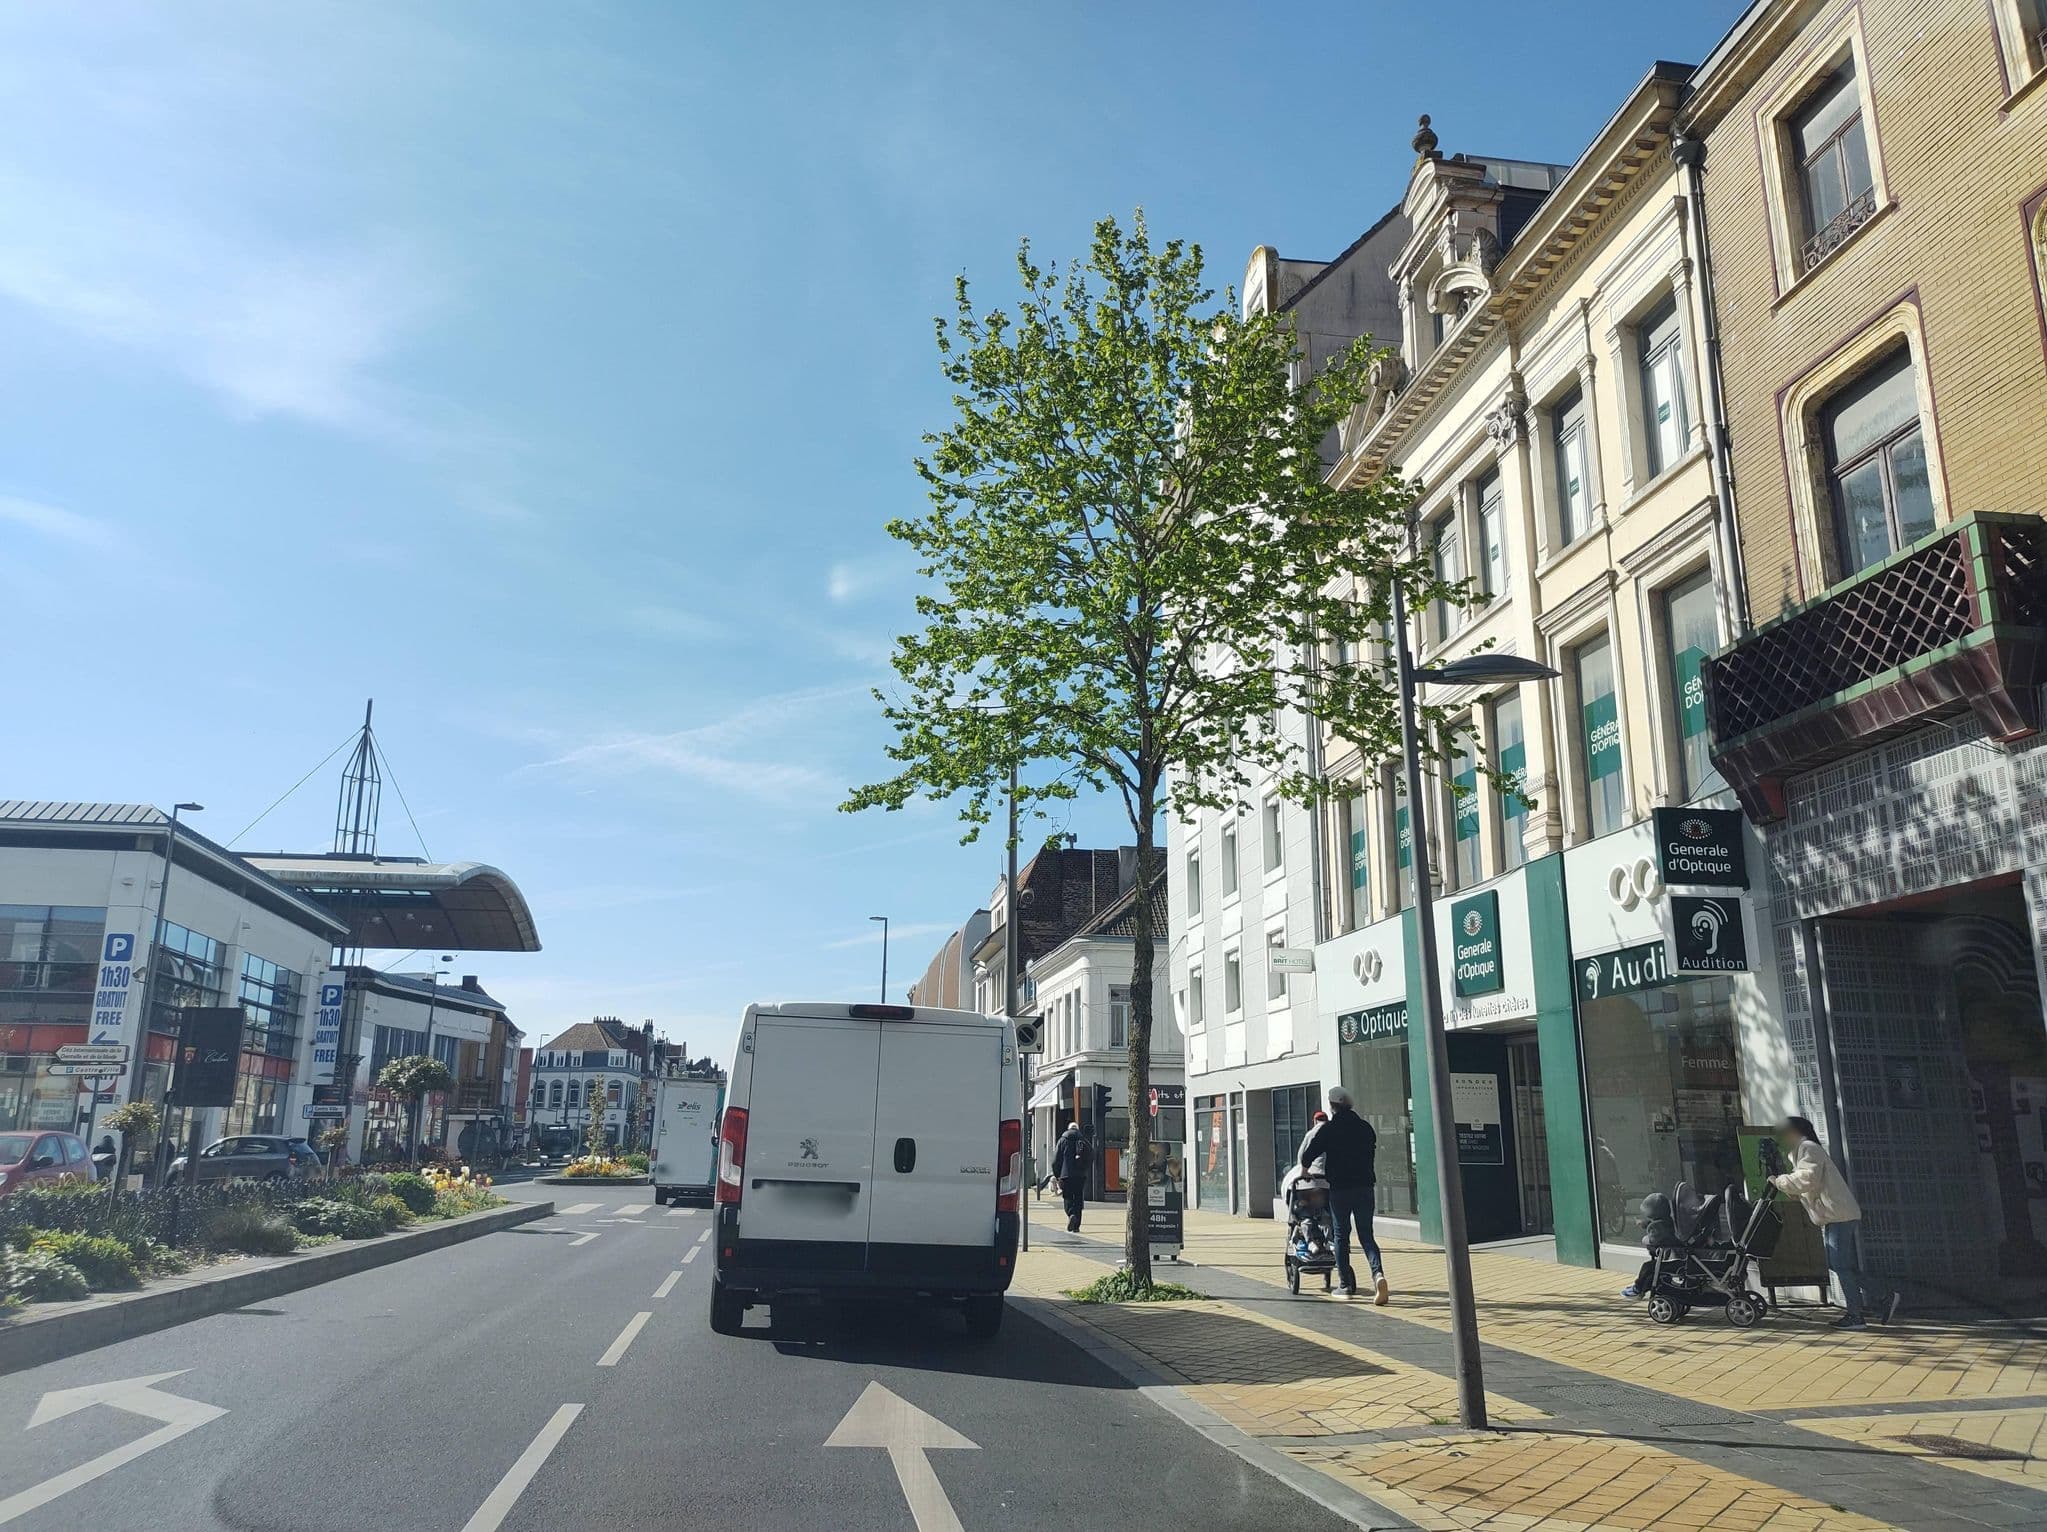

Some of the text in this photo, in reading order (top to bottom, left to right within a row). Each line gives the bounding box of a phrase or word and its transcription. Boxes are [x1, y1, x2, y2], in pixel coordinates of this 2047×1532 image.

[1669, 842, 1728, 857] Generale
[1669, 858, 1732, 875] d'Optique
[1457, 938, 1492, 960] Generale
[1458, 960, 1495, 980] d'Optique
[1612, 946, 1666, 989] Audi
[1682, 956, 1745, 970] Audition
[101, 965, 130, 988] 1h30
[96, 990, 128, 1008] GRATUIT
[95, 1011, 122, 1025] FREE
[319, 1008, 340, 1026] 1h30
[1361, 1008, 1408, 1039] Optique
[316, 1030, 339, 1044] GRATUIT
[314, 1049, 336, 1062] FREE
[1682, 1056, 1730, 1070] Femme
[1174, 1090, 1184, 1098] et
[1150, 1214, 1167, 1222] 48h
